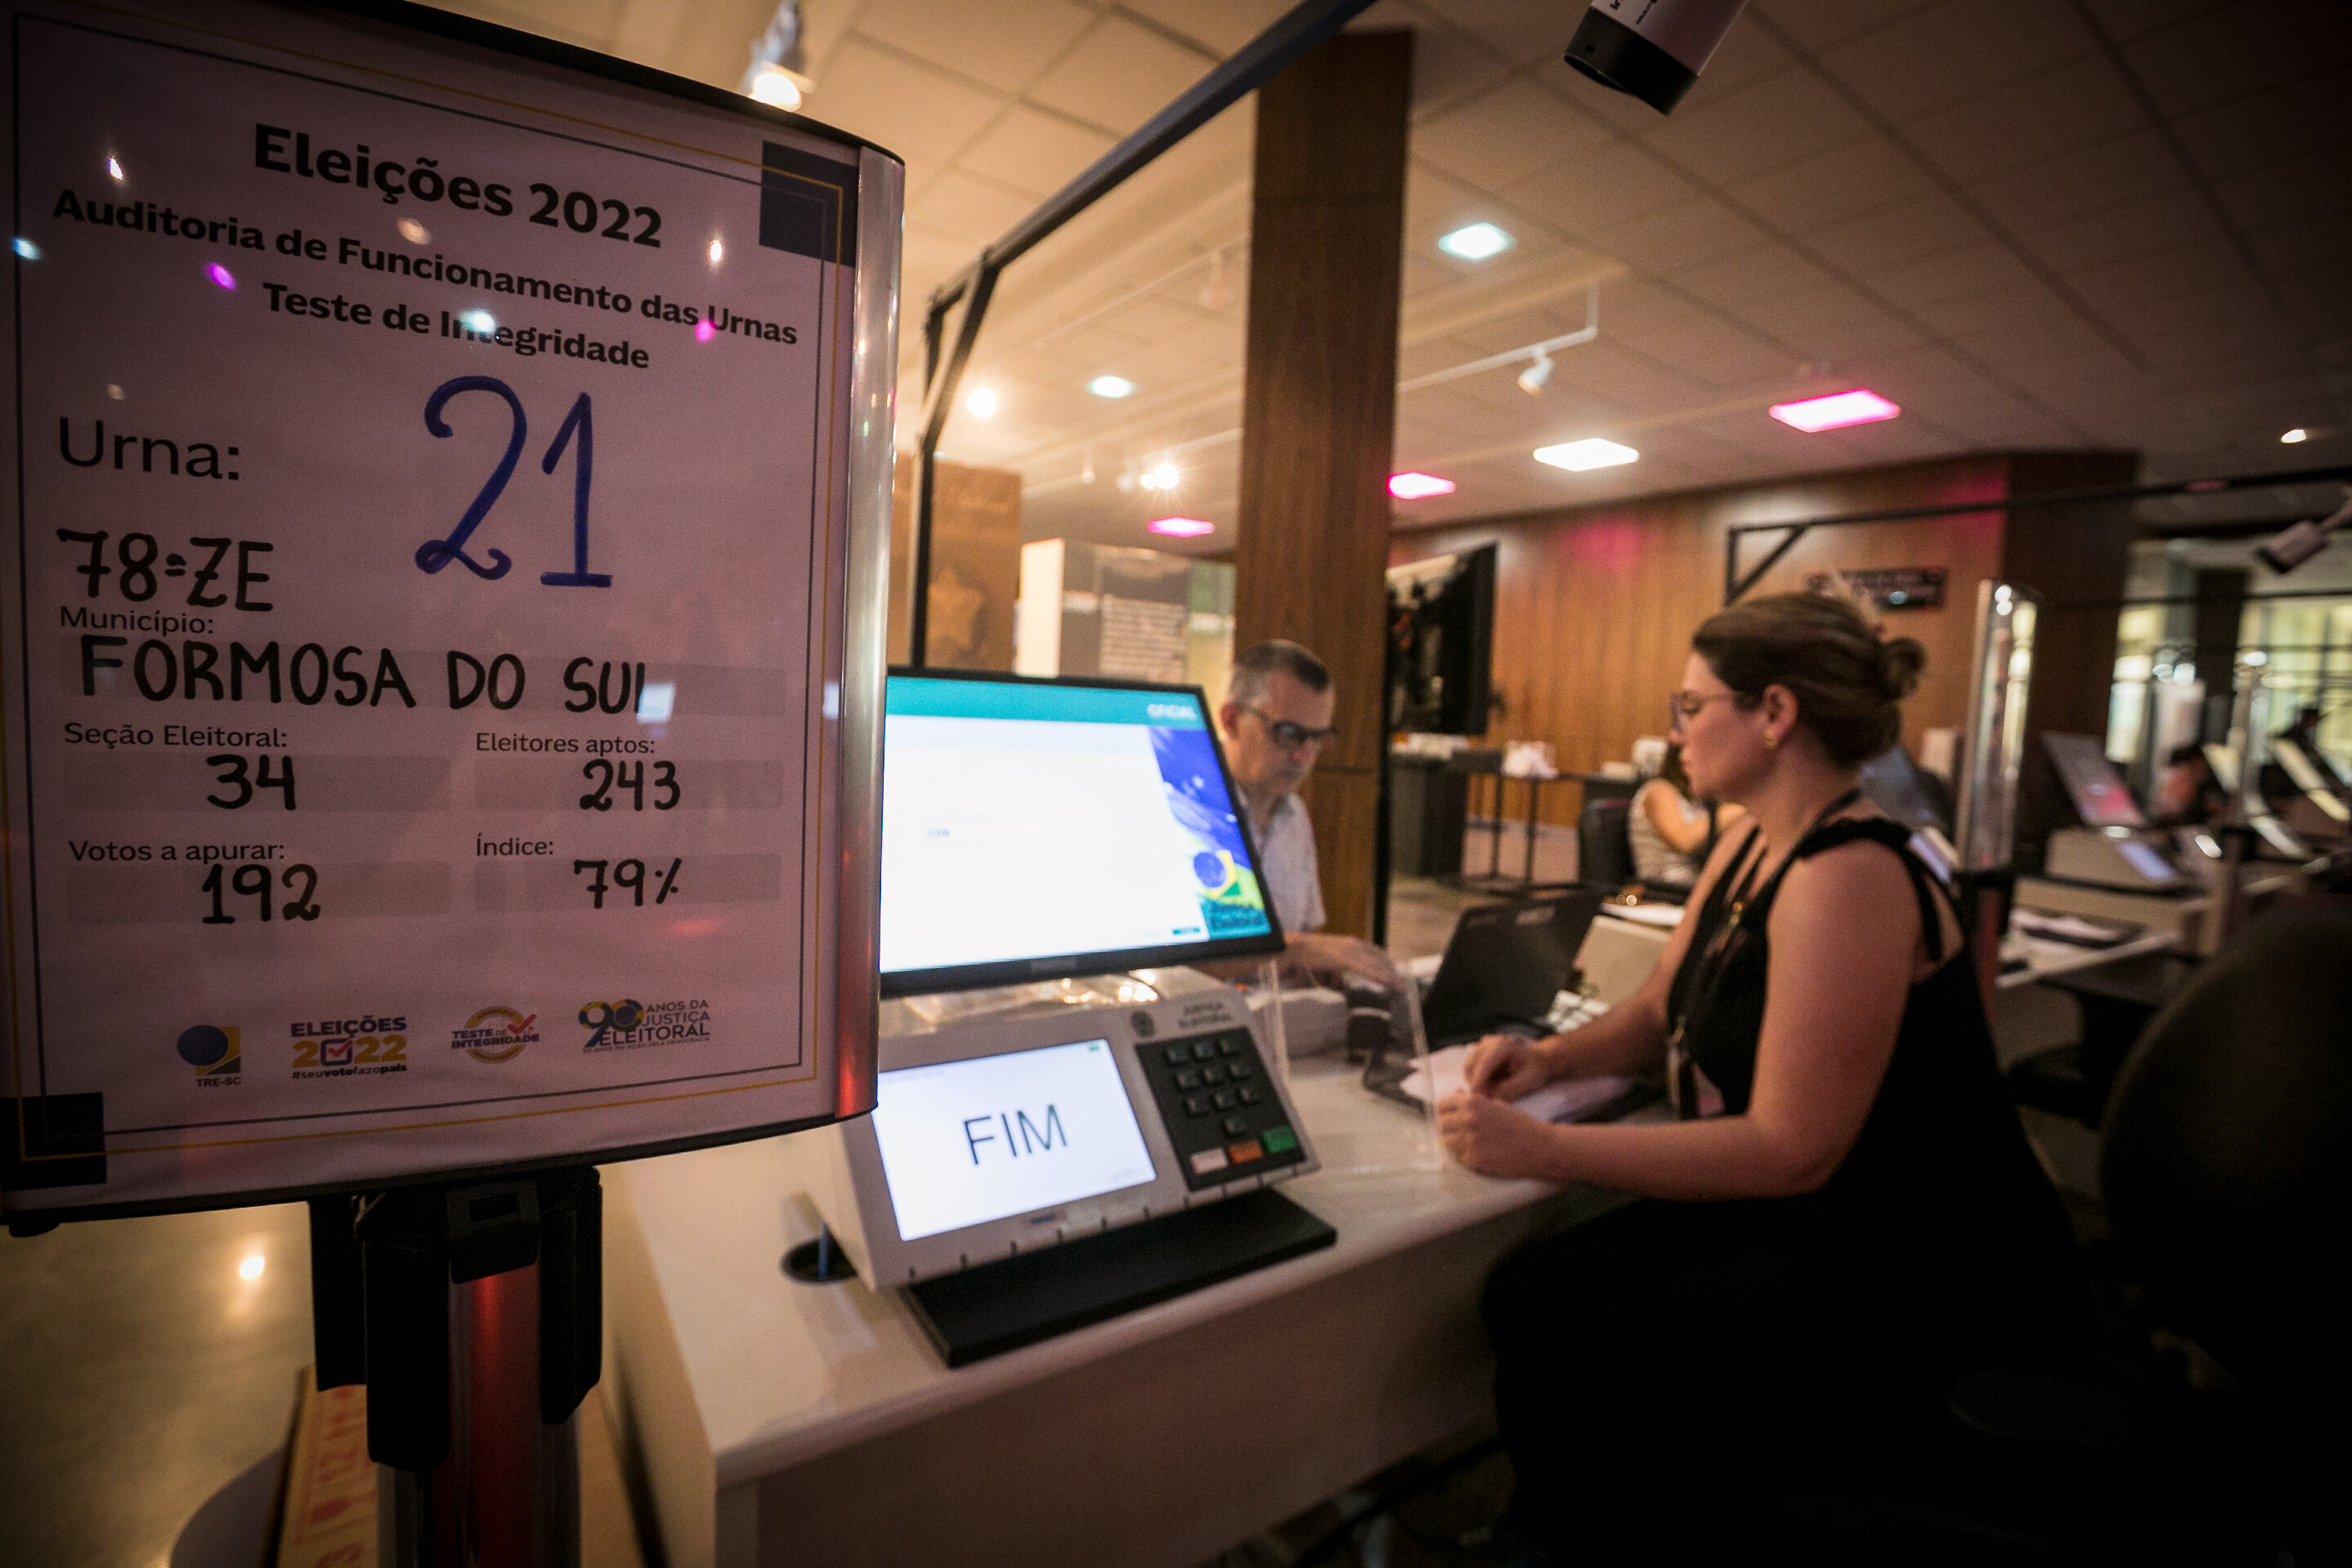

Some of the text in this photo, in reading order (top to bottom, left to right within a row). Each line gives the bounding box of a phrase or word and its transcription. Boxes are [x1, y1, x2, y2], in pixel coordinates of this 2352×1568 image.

[254, 123, 662, 248] Eleições 2022
[52, 188, 798, 345] Auditoria de Funcionamento das Urnas
[263, 282, 372, 326] Teste
[382, 302, 430, 337] de
[58, 416, 241, 482] Urna:
[415, 376, 613, 588] 21
[60, 606, 214, 637] Município:
[81, 635, 416, 708] FORMOSA
[447, 650, 526, 710] DO
[65, 723, 287, 749] Seção Eleitoral:
[476, 733, 655, 758] Eleitores aptos:
[206, 754, 296, 811] 34
[579, 759, 681, 811] 243
[69, 841, 285, 866] Votos a apurar:
[476, 832, 554, 857] Índice:
[202, 863, 321, 924] 192
[573, 858, 683, 909] 79%
[643, 1011, 710, 1027] JUSTIÇA
[646, 999, 709, 1013] ANOS DA
[291, 1015, 408, 1037] ELEIÇÕES
[452, 1028, 493, 1040] TESTE
[452, 1033, 540, 1049] INTEGRIDADE
[599, 1022, 710, 1046] ELEITORAL
[196, 1076, 242, 1088] TRE-SC
[963, 1104, 1067, 1165] FIM
